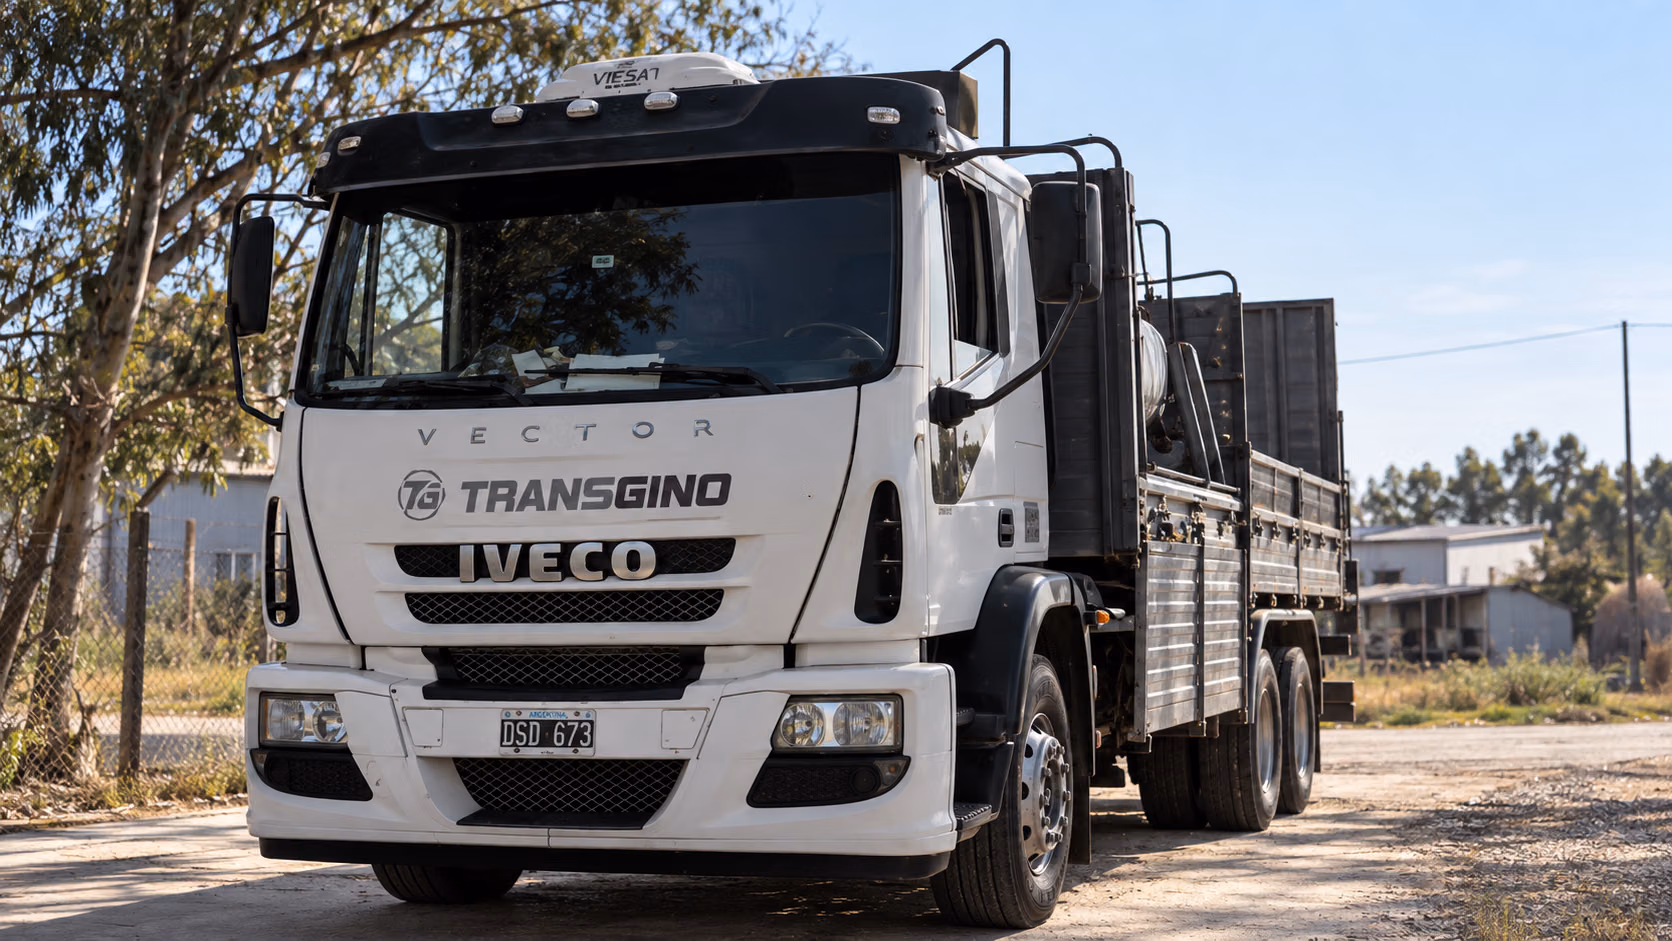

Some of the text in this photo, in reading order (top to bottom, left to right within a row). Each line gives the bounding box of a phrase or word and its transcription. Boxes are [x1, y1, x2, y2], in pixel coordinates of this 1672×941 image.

[417, 419, 715, 446] VECTOR
[460, 473, 732, 513] TRANSGINO
[459, 541, 657, 582] IVECO
[502, 721, 592, 746] DSD 673
